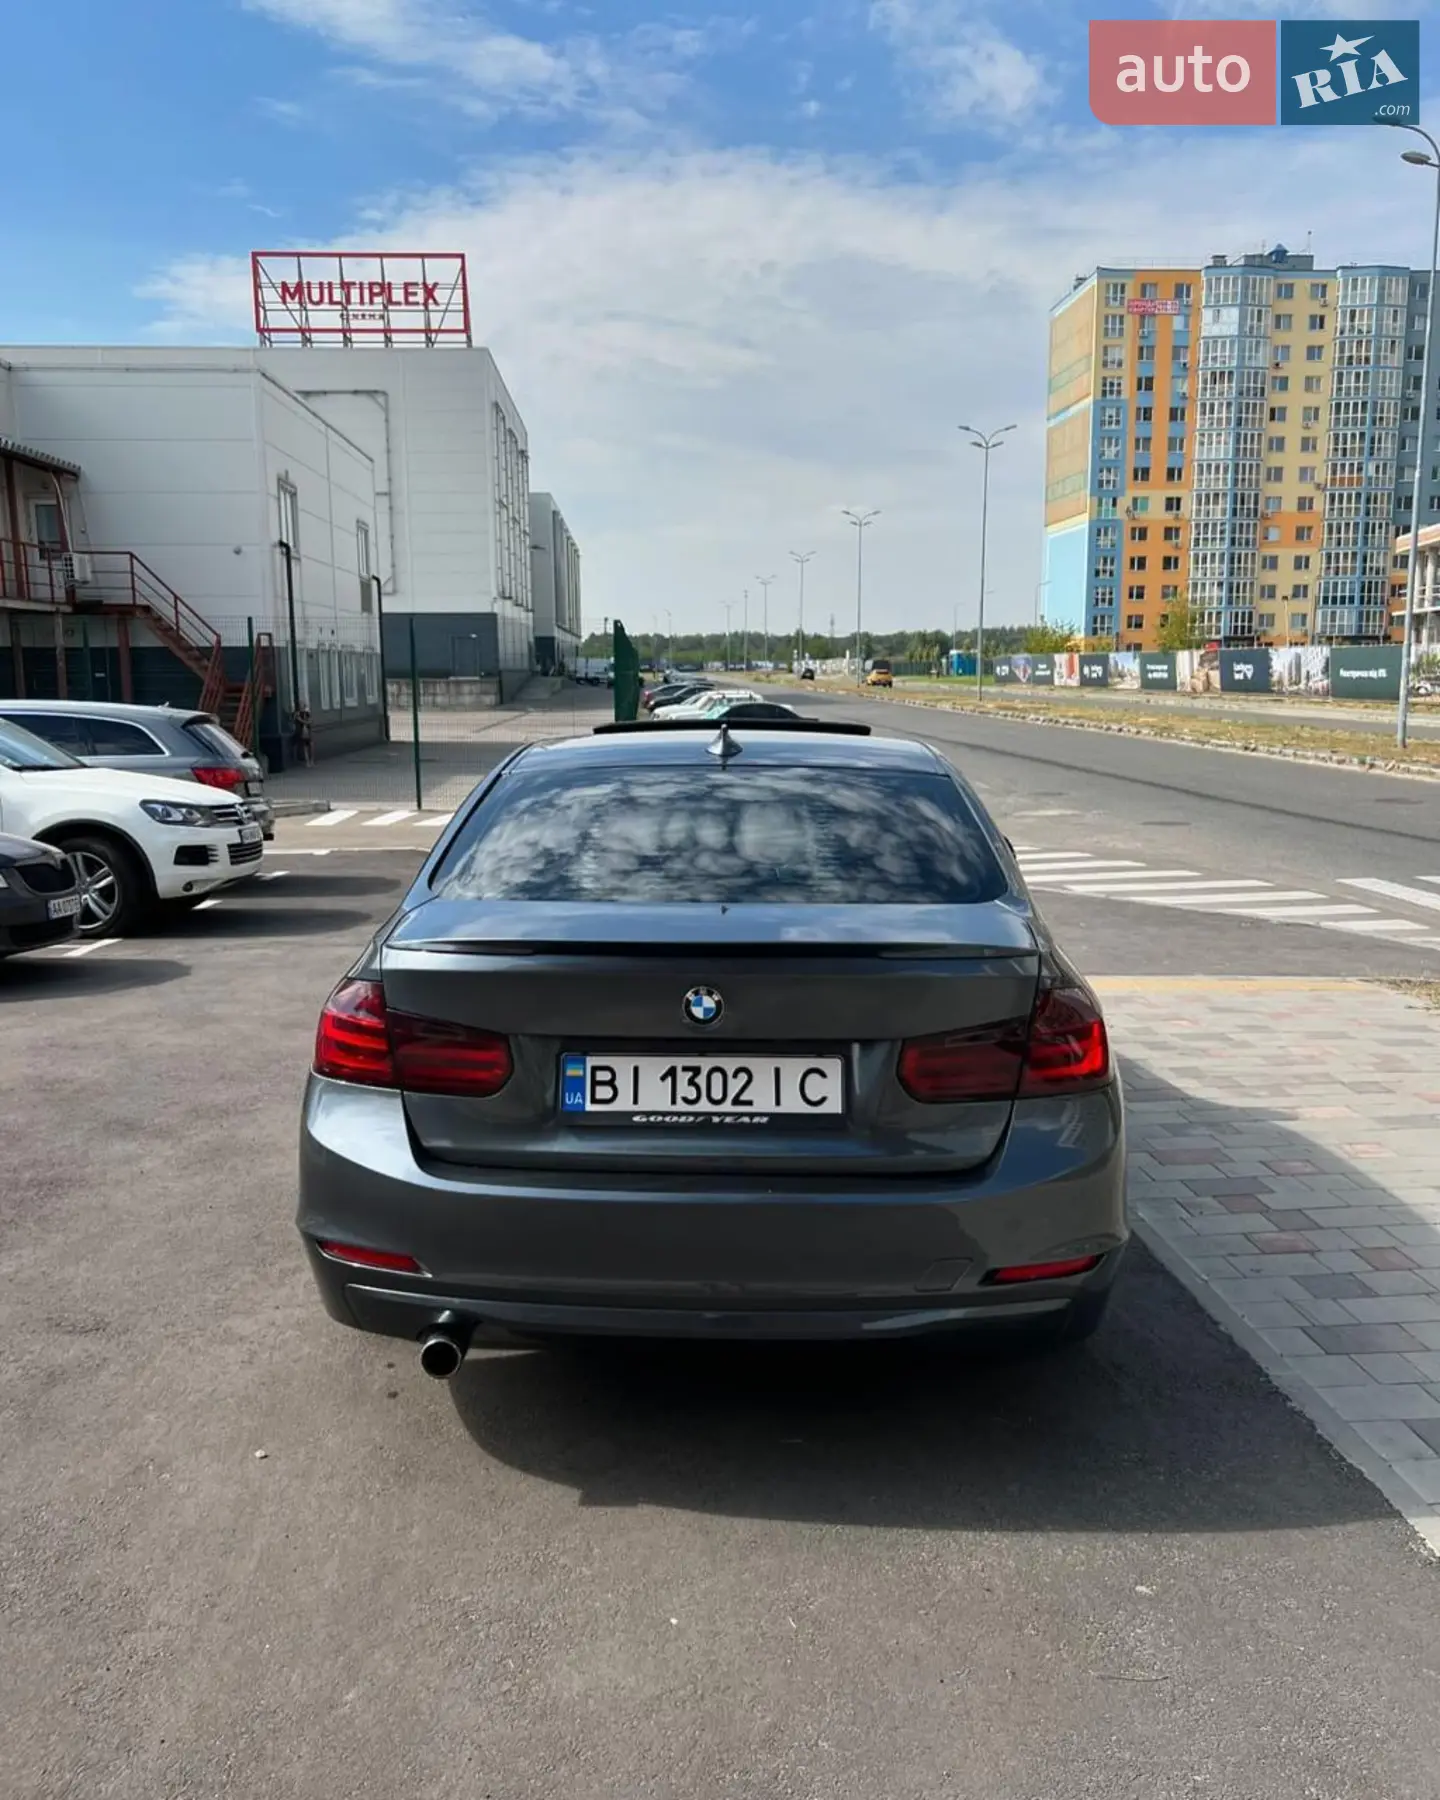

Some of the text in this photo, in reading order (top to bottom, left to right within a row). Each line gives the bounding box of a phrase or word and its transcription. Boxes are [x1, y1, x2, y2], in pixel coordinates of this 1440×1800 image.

[281, 281, 440, 306] MULTIPLEX
[565, 1092, 583, 1104] UA
[660, 1066, 753, 1106] 1302
